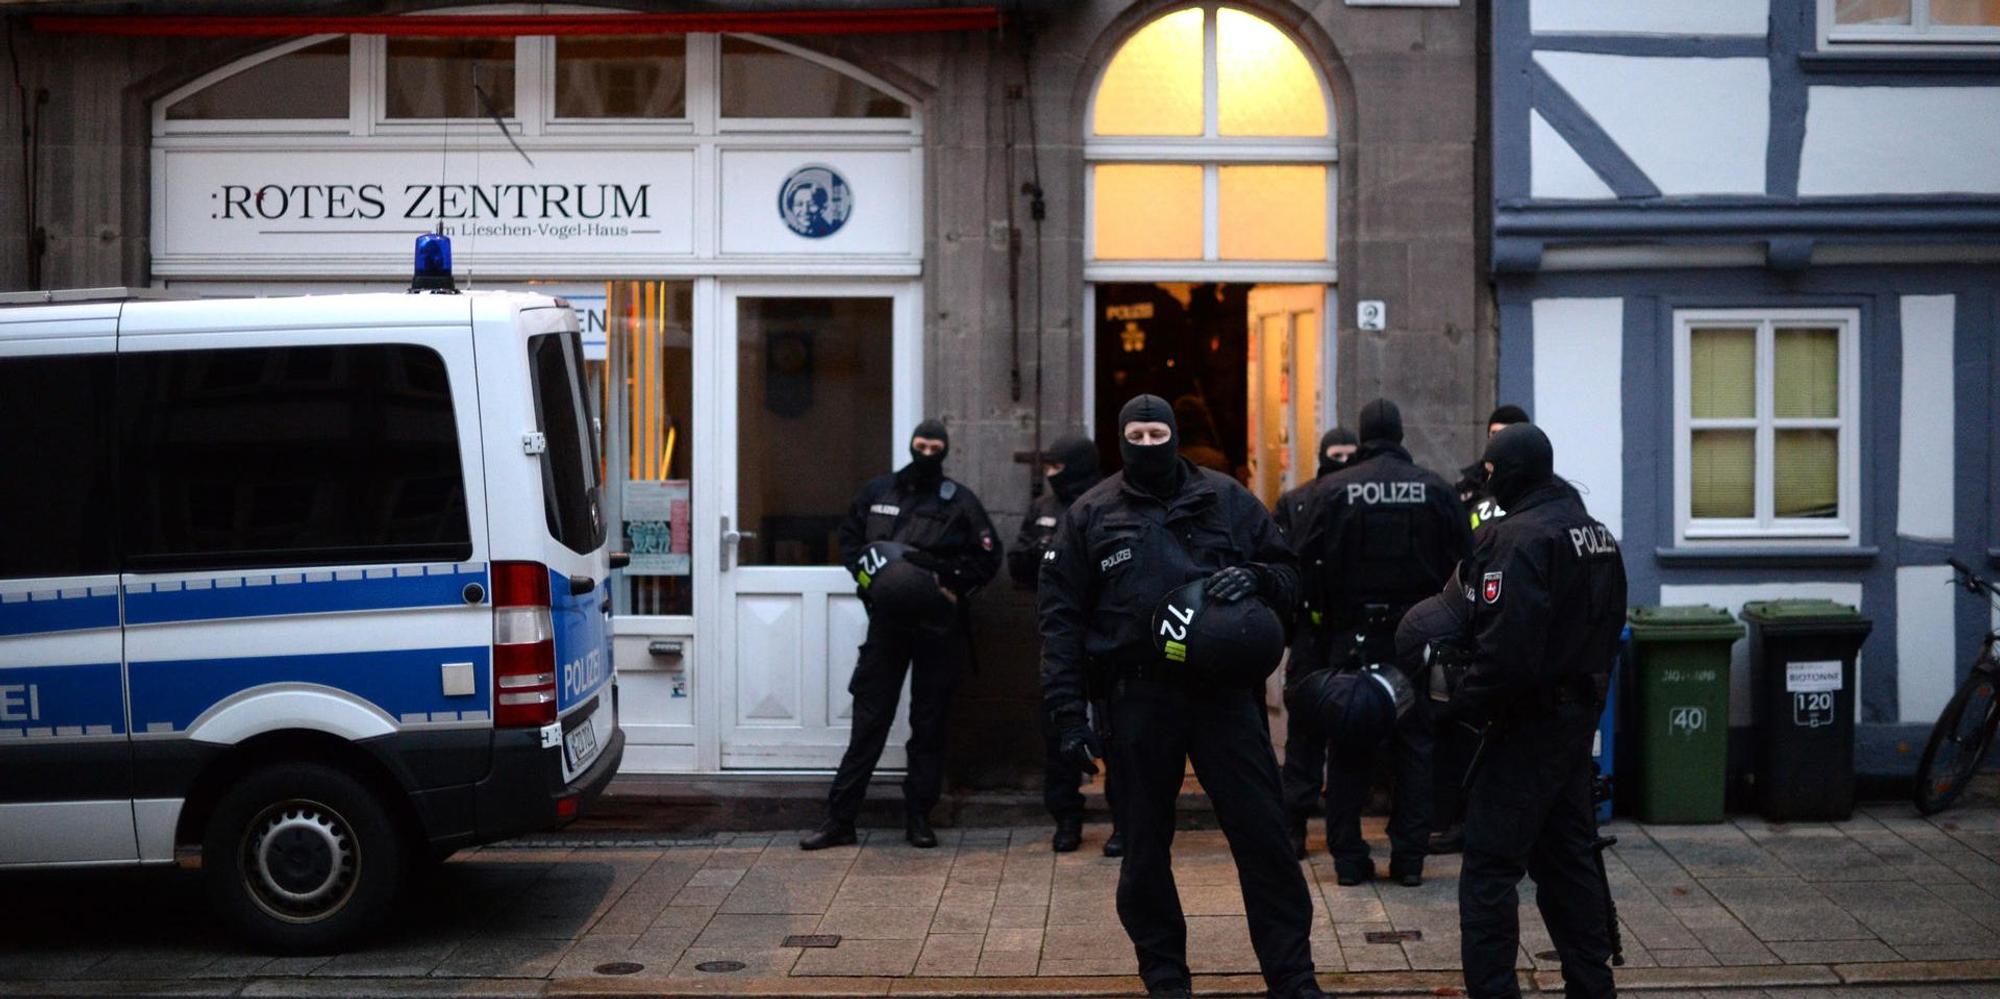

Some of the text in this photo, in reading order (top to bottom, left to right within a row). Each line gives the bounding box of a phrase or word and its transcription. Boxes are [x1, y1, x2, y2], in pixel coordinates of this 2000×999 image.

[403, 184, 652, 219] ZENTRUM
[461, 223, 629, 240] Lieschen-Vogel-Haus
[1347, 482, 1426, 505] POLIZEI
[858, 546, 888, 576] 72
[1100, 548, 1133, 572] POLIZEI
[1160, 603, 1195, 641] 72
[0, 684, 40, 720] EI
[1798, 693, 1831, 711] 120
[1673, 708, 1702, 729] 40
